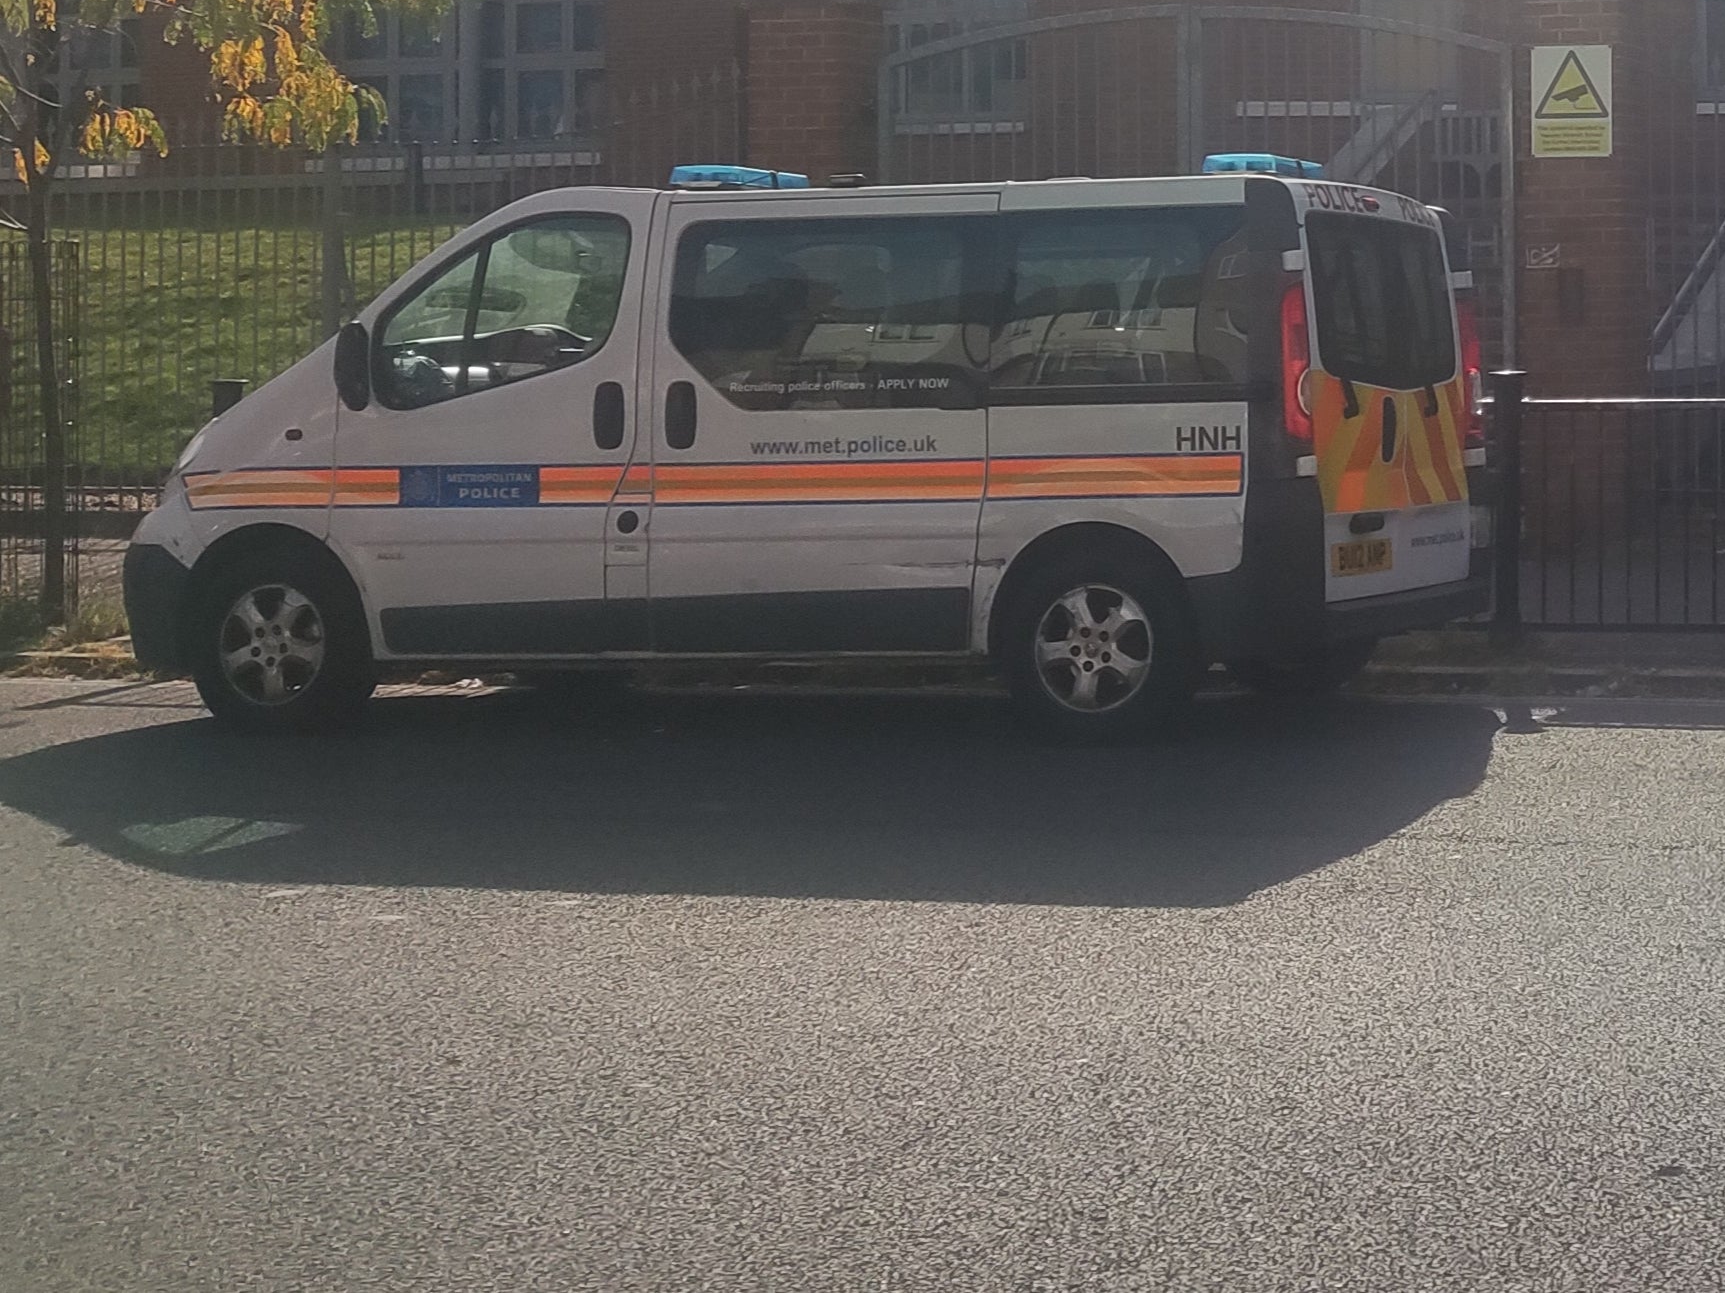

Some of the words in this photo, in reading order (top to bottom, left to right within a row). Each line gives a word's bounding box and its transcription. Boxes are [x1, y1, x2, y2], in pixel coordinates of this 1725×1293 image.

[1302, 184, 1364, 213] POLICE
[728, 381, 785, 395] Recruiting
[787, 380, 820, 393] police
[823, 379, 867, 392] officers
[876, 378, 915, 391] APPLY
[918, 377, 950, 390] NOW
[749, 434, 938, 457] www.met.police.uk
[1175, 424, 1242, 452] HNH
[446, 472, 533, 483] METROPOLITAN
[458, 486, 522, 499] POLICE
